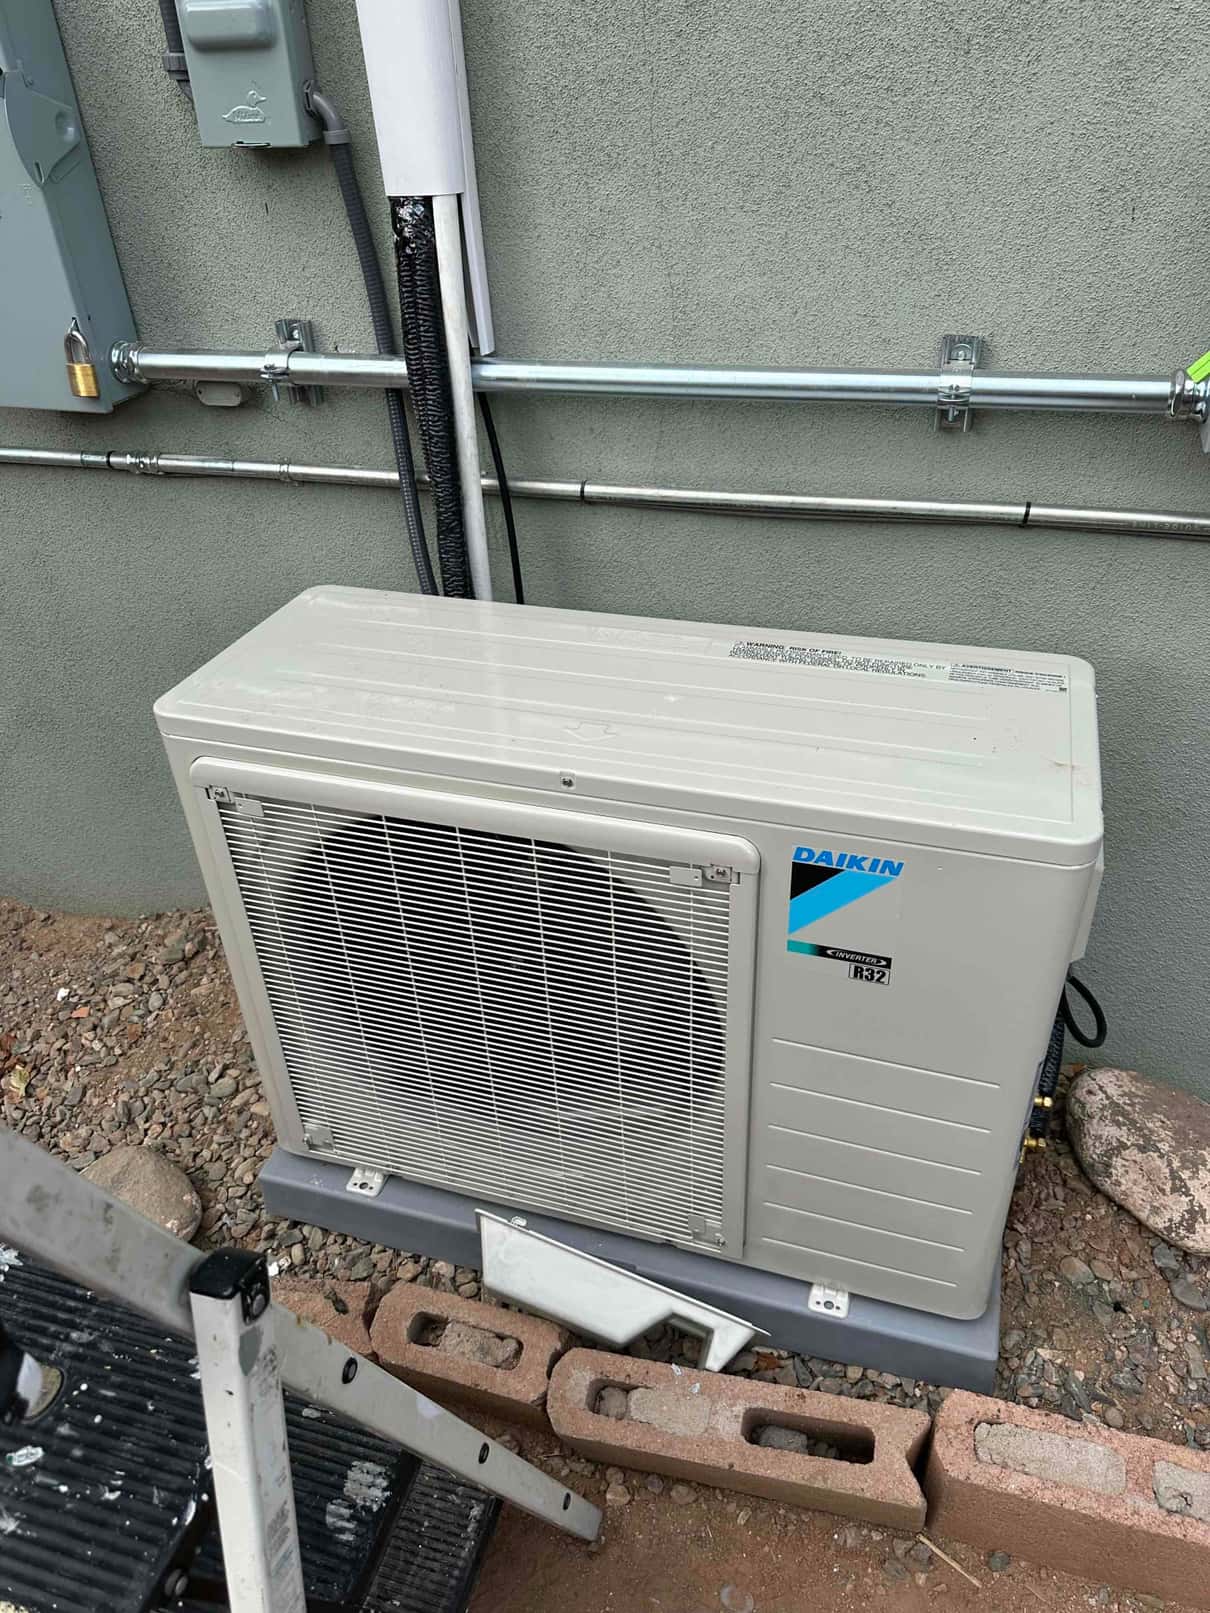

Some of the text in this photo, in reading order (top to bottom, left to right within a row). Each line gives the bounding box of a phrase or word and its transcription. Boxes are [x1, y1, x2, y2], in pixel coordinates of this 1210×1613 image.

[793, 847, 904, 876] DAIKIN
[836, 951, 878, 964] INVERTER
[853, 965, 886, 984] R32
